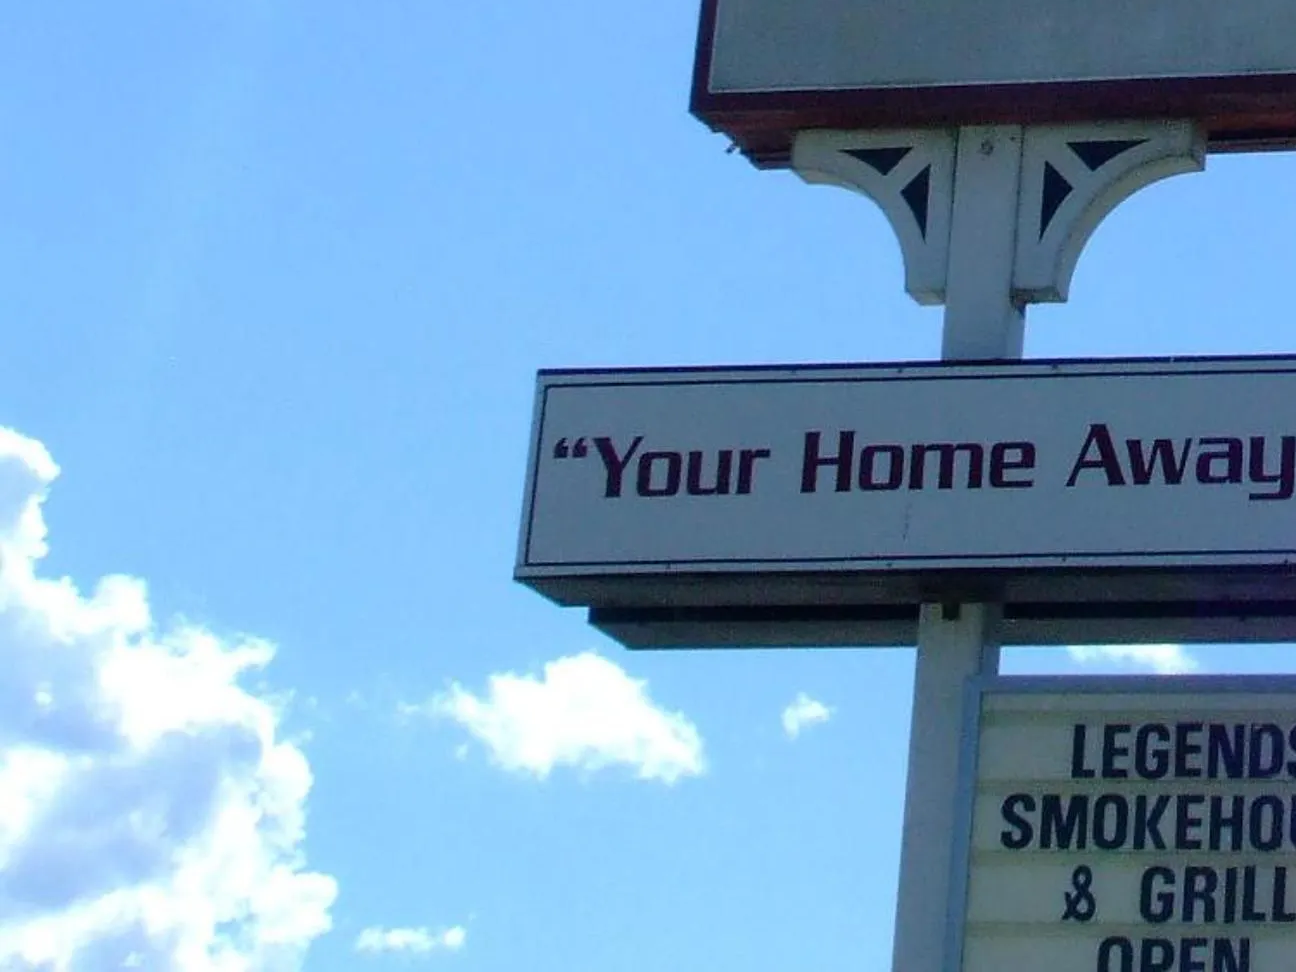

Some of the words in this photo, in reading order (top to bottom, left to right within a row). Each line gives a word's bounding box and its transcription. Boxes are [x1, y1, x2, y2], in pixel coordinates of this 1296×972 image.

[800, 430, 1036, 493] Home
[1065, 423, 1296, 501] Away
[1061, 865, 1096, 922] &
[1139, 865, 1296, 924] GRILL
[1096, 936, 1251, 972] OPEN
